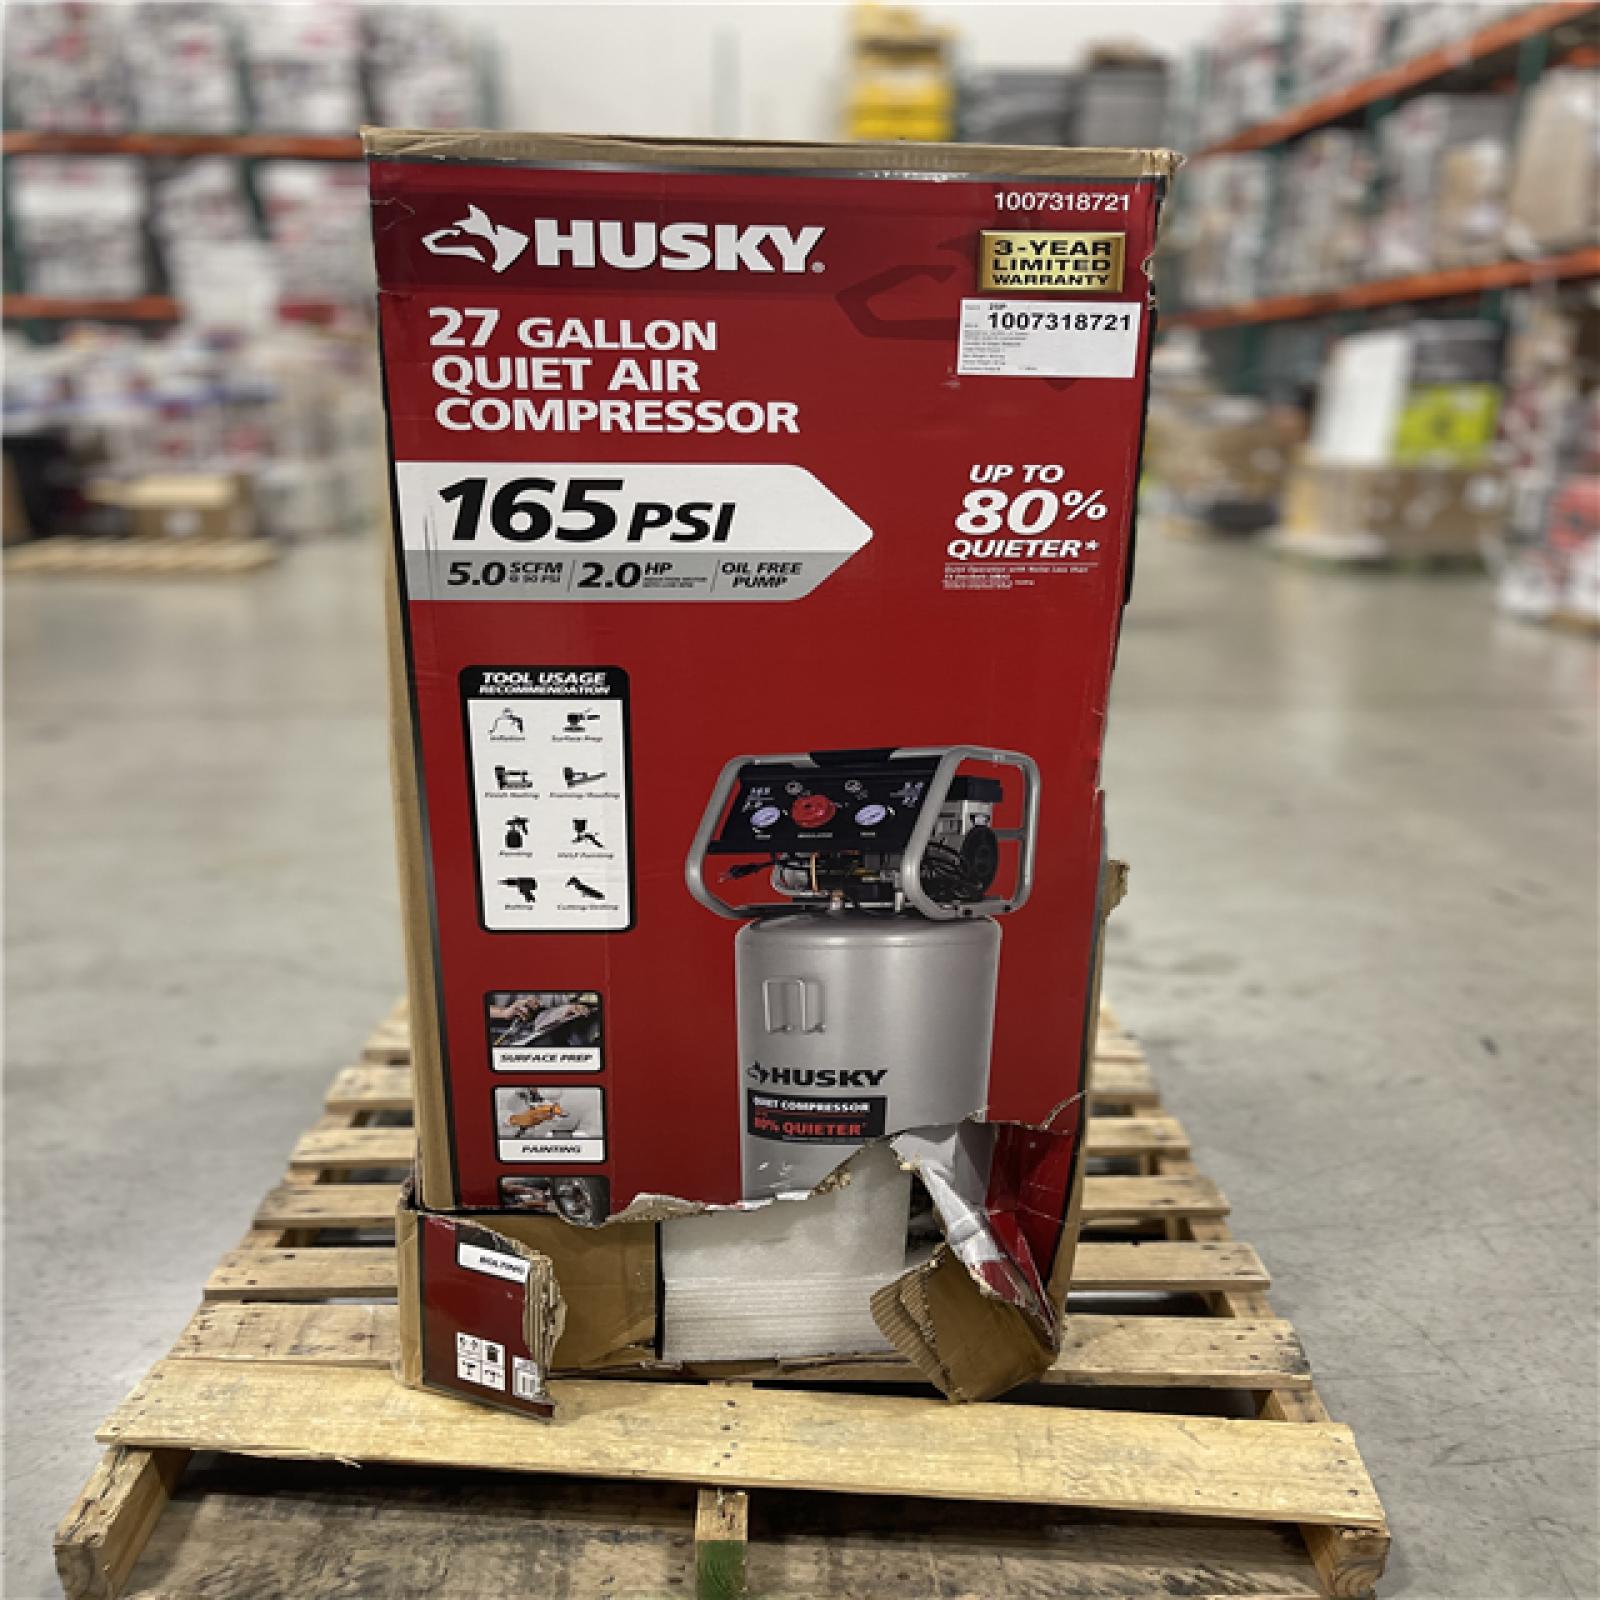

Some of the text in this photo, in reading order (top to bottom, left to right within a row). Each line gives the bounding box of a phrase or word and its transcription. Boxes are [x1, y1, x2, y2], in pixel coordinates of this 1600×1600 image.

[995, 191, 1129, 211] 1007318721
[534, 218, 826, 273] HUSKY
[994, 239, 1112, 256] 3-YEAR
[992, 259, 1111, 271] LIMITED
[992, 274, 1110, 286] WARRANTY
[429, 307, 718, 351] 27 GALLON
[987, 312, 1131, 331] 1007318721
[431, 355, 701, 395] QUIET AIR
[435, 398, 801, 434] COMPRESSOR
[969, 464, 1066, 484] UP TO
[438, 477, 736, 543] 165 PSI
[954, 488, 1109, 536] 80%
[447, 561, 563, 586] 5.0 SCFM
[577, 561, 642, 589] 2.0
[644, 561, 673, 576] HP
[721, 561, 803, 576] OIL FREE
[732, 576, 789, 588] PUMP
[482, 672, 608, 685] TOOL USAGE
[479, 684, 611, 696] RECOMMENDATION
[501, 1054, 593, 1063] SURFACE PREP
[771, 1066, 889, 1087] HUSKY
[781, 1101, 871, 1112] COMPRESSOR
[521, 1144, 581, 1153] PAINTING
